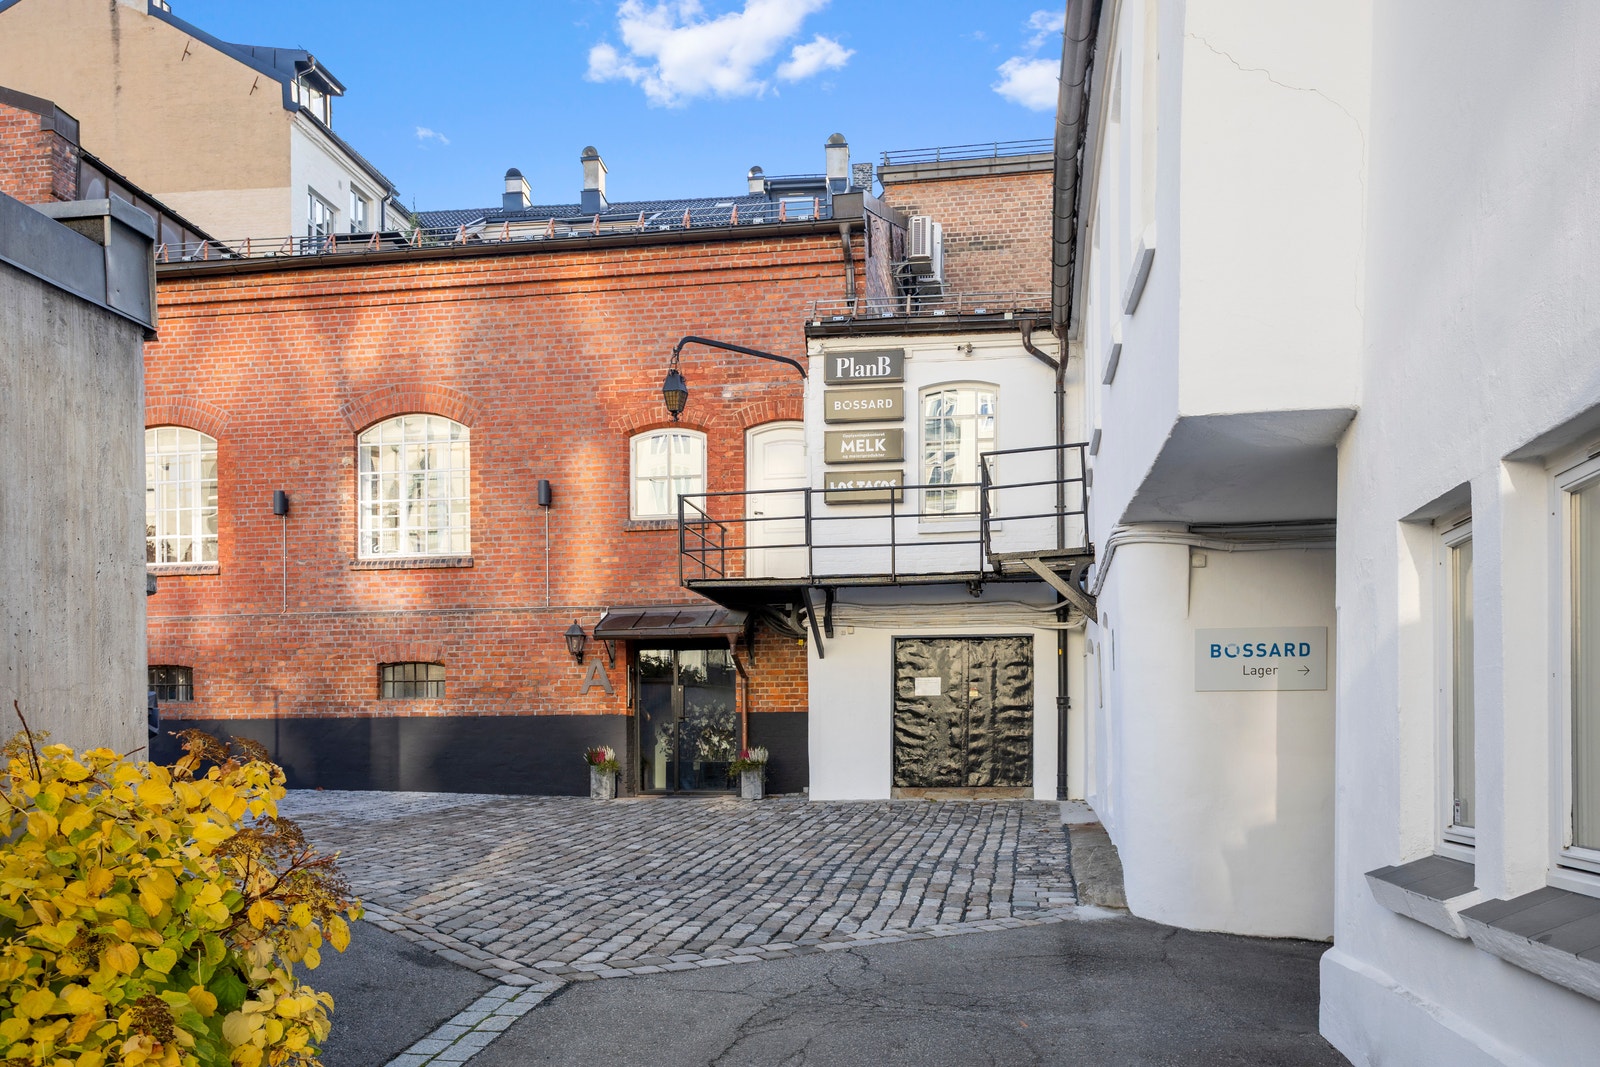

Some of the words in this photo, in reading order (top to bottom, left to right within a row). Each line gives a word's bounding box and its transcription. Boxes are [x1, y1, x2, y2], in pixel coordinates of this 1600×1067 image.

[835, 356, 891, 378] PlanB
[834, 398, 893, 411] BOSSARD
[841, 438, 886, 453] MELK
[830, 480, 854, 490] LOS
[1210, 642, 1311, 658] BOSSARD
[580, 658, 614, 694] A
[1242, 665, 1278, 679] Lager
